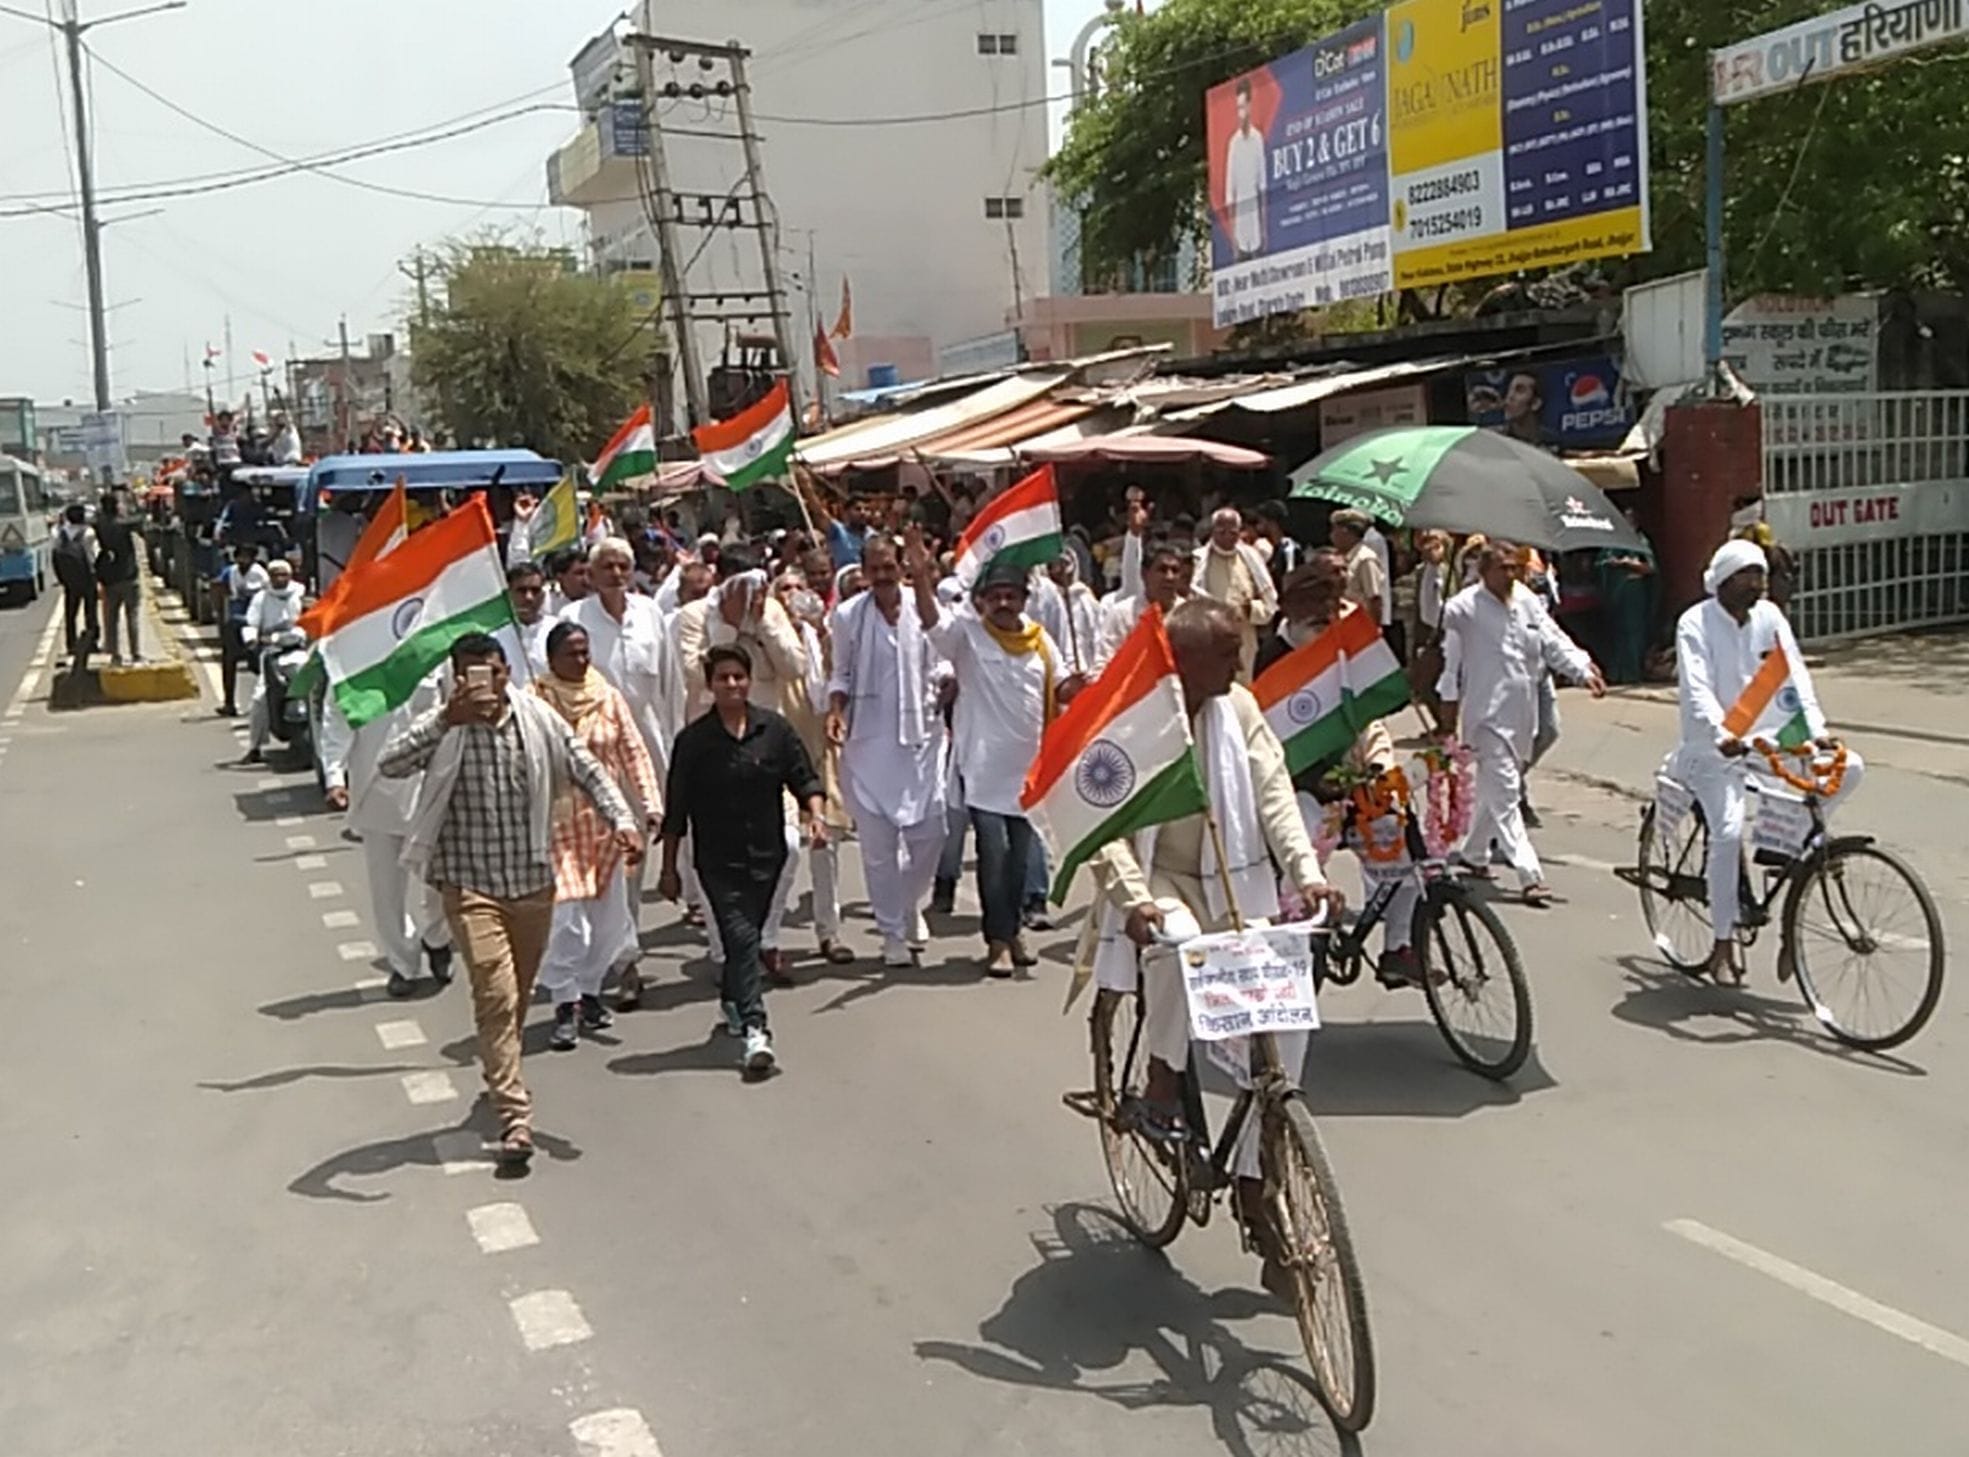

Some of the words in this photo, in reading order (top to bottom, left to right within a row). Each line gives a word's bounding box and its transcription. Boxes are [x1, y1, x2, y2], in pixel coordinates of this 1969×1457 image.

[1839, 0, 1961, 62] हरियाणा
[1766, 28, 1838, 80] OUT
[1272, 140, 1304, 179] BUY
[1306, 137, 1315, 168] 2
[1317, 132, 1330, 163] &
[1334, 117, 1368, 158] GET
[1371, 108, 1381, 146] 6
[1562, 408, 1627, 431] PEPSI
[1810, 501, 1848, 528] OUT
[1853, 497, 1899, 524] GATE
[1198, 1011, 1253, 1033] किसान
[1257, 1002, 1314, 1025] आंदोलन
